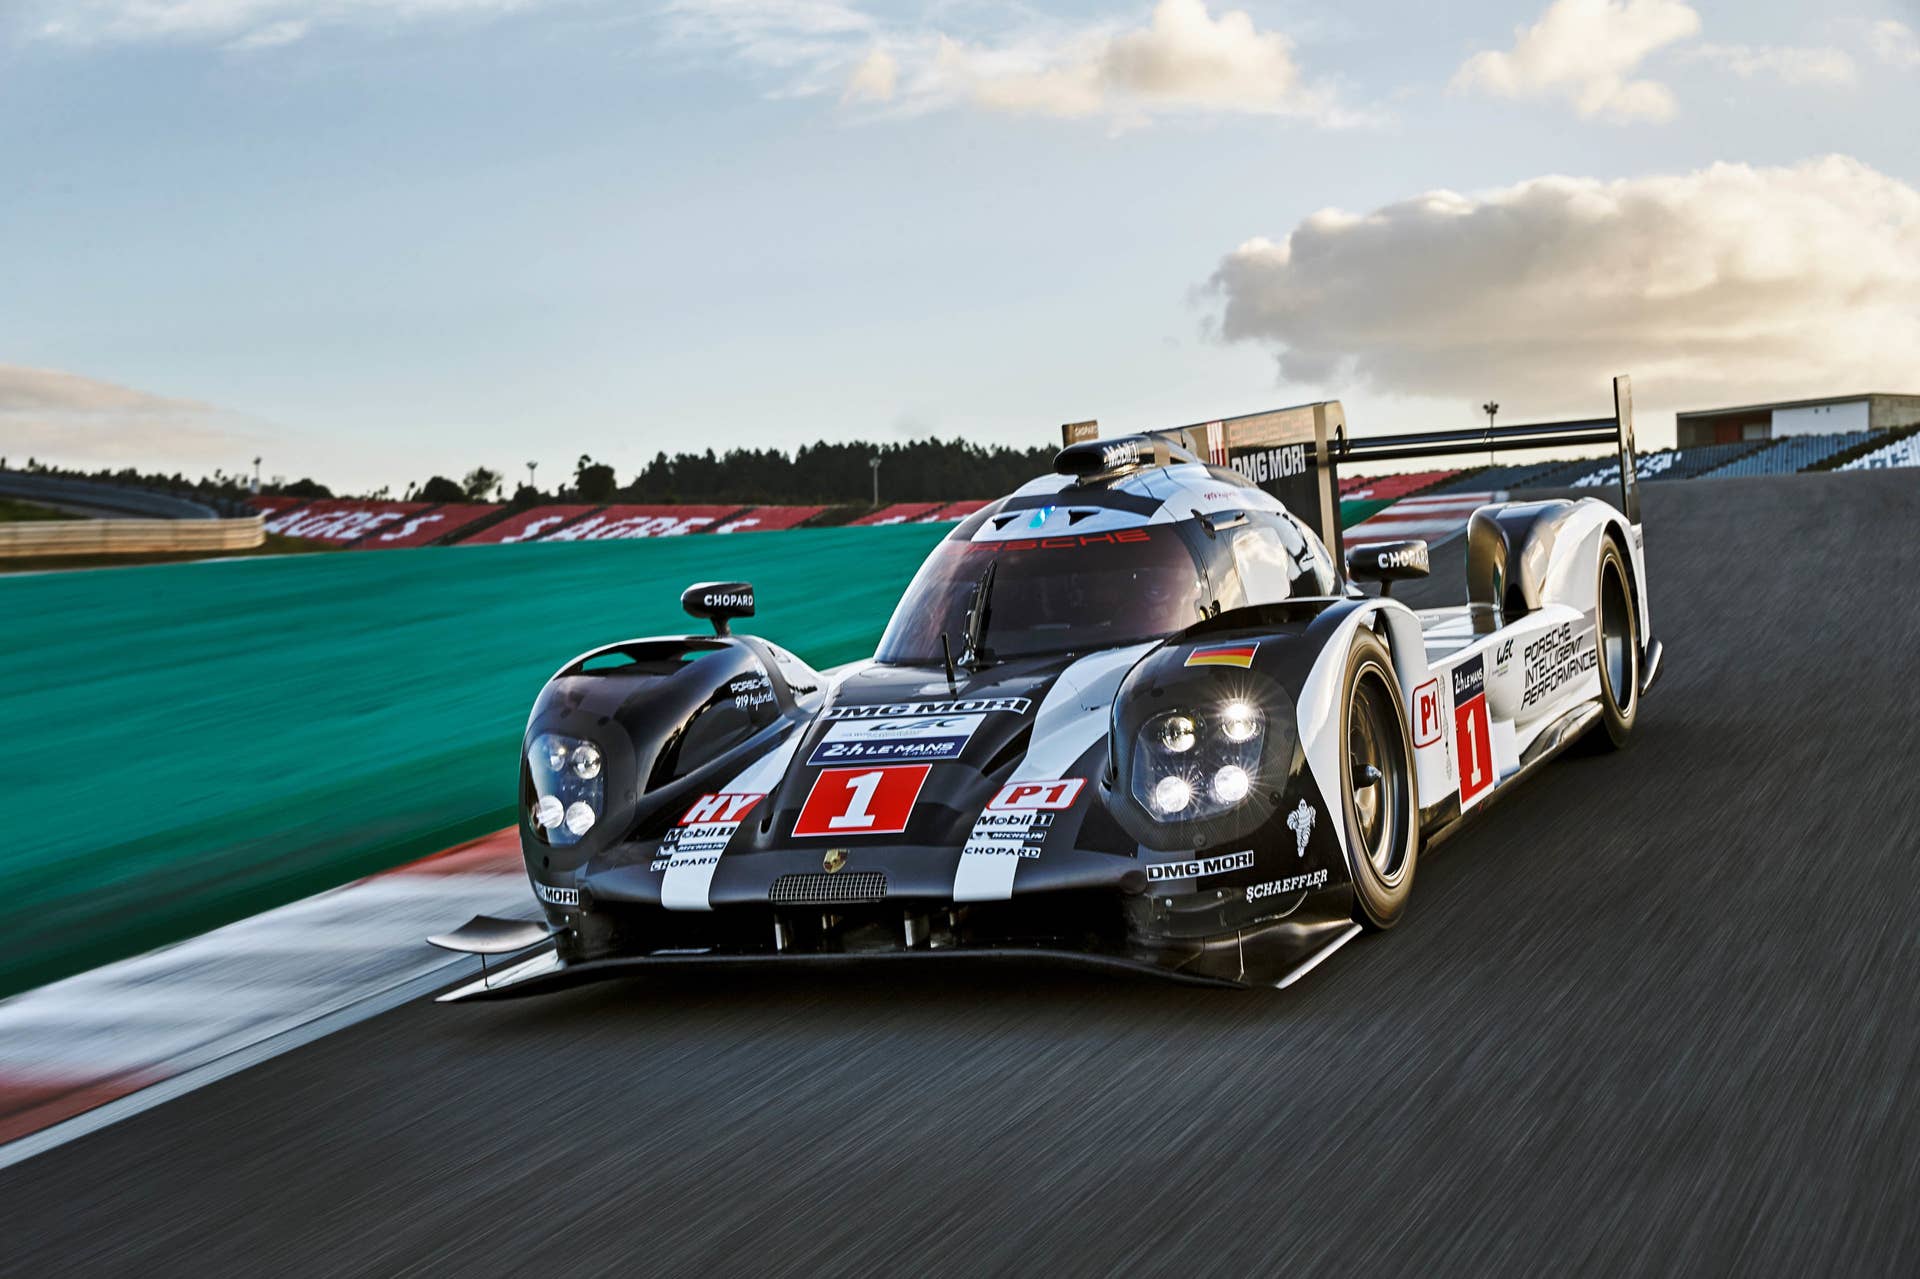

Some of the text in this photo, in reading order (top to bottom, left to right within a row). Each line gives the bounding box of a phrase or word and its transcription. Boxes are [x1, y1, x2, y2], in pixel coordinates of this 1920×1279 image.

[1268, 444, 1307, 480] MORI
[704, 594, 754, 607] CHOPARD
[1524, 621, 1572, 667] PORSCHE
[1525, 635, 1584, 689] INTELLIGENT
[1521, 648, 1597, 711] PERFORMANCE
[735, 689, 774, 711] 919 hybrid
[914, 699, 1030, 714] MORI
[1421, 690, 1439, 737] P1
[866, 745, 893, 756] LE
[894, 742, 955, 755] MANS
[1467, 708, 1482, 787] 1
[828, 771, 884, 829] 1
[1005, 784, 1068, 805] P1
[682, 794, 762, 823] HY
[977, 814, 1032, 826] Mobil
[664, 827, 718, 842] Mobil
[651, 857, 718, 871] CHOPARD
[965, 847, 1039, 857] CHOPARD
[1149, 852, 1253, 879] DMG MORI
[544, 887, 578, 904] MORI
[1246, 869, 1328, 901] SCHAEFFLER
